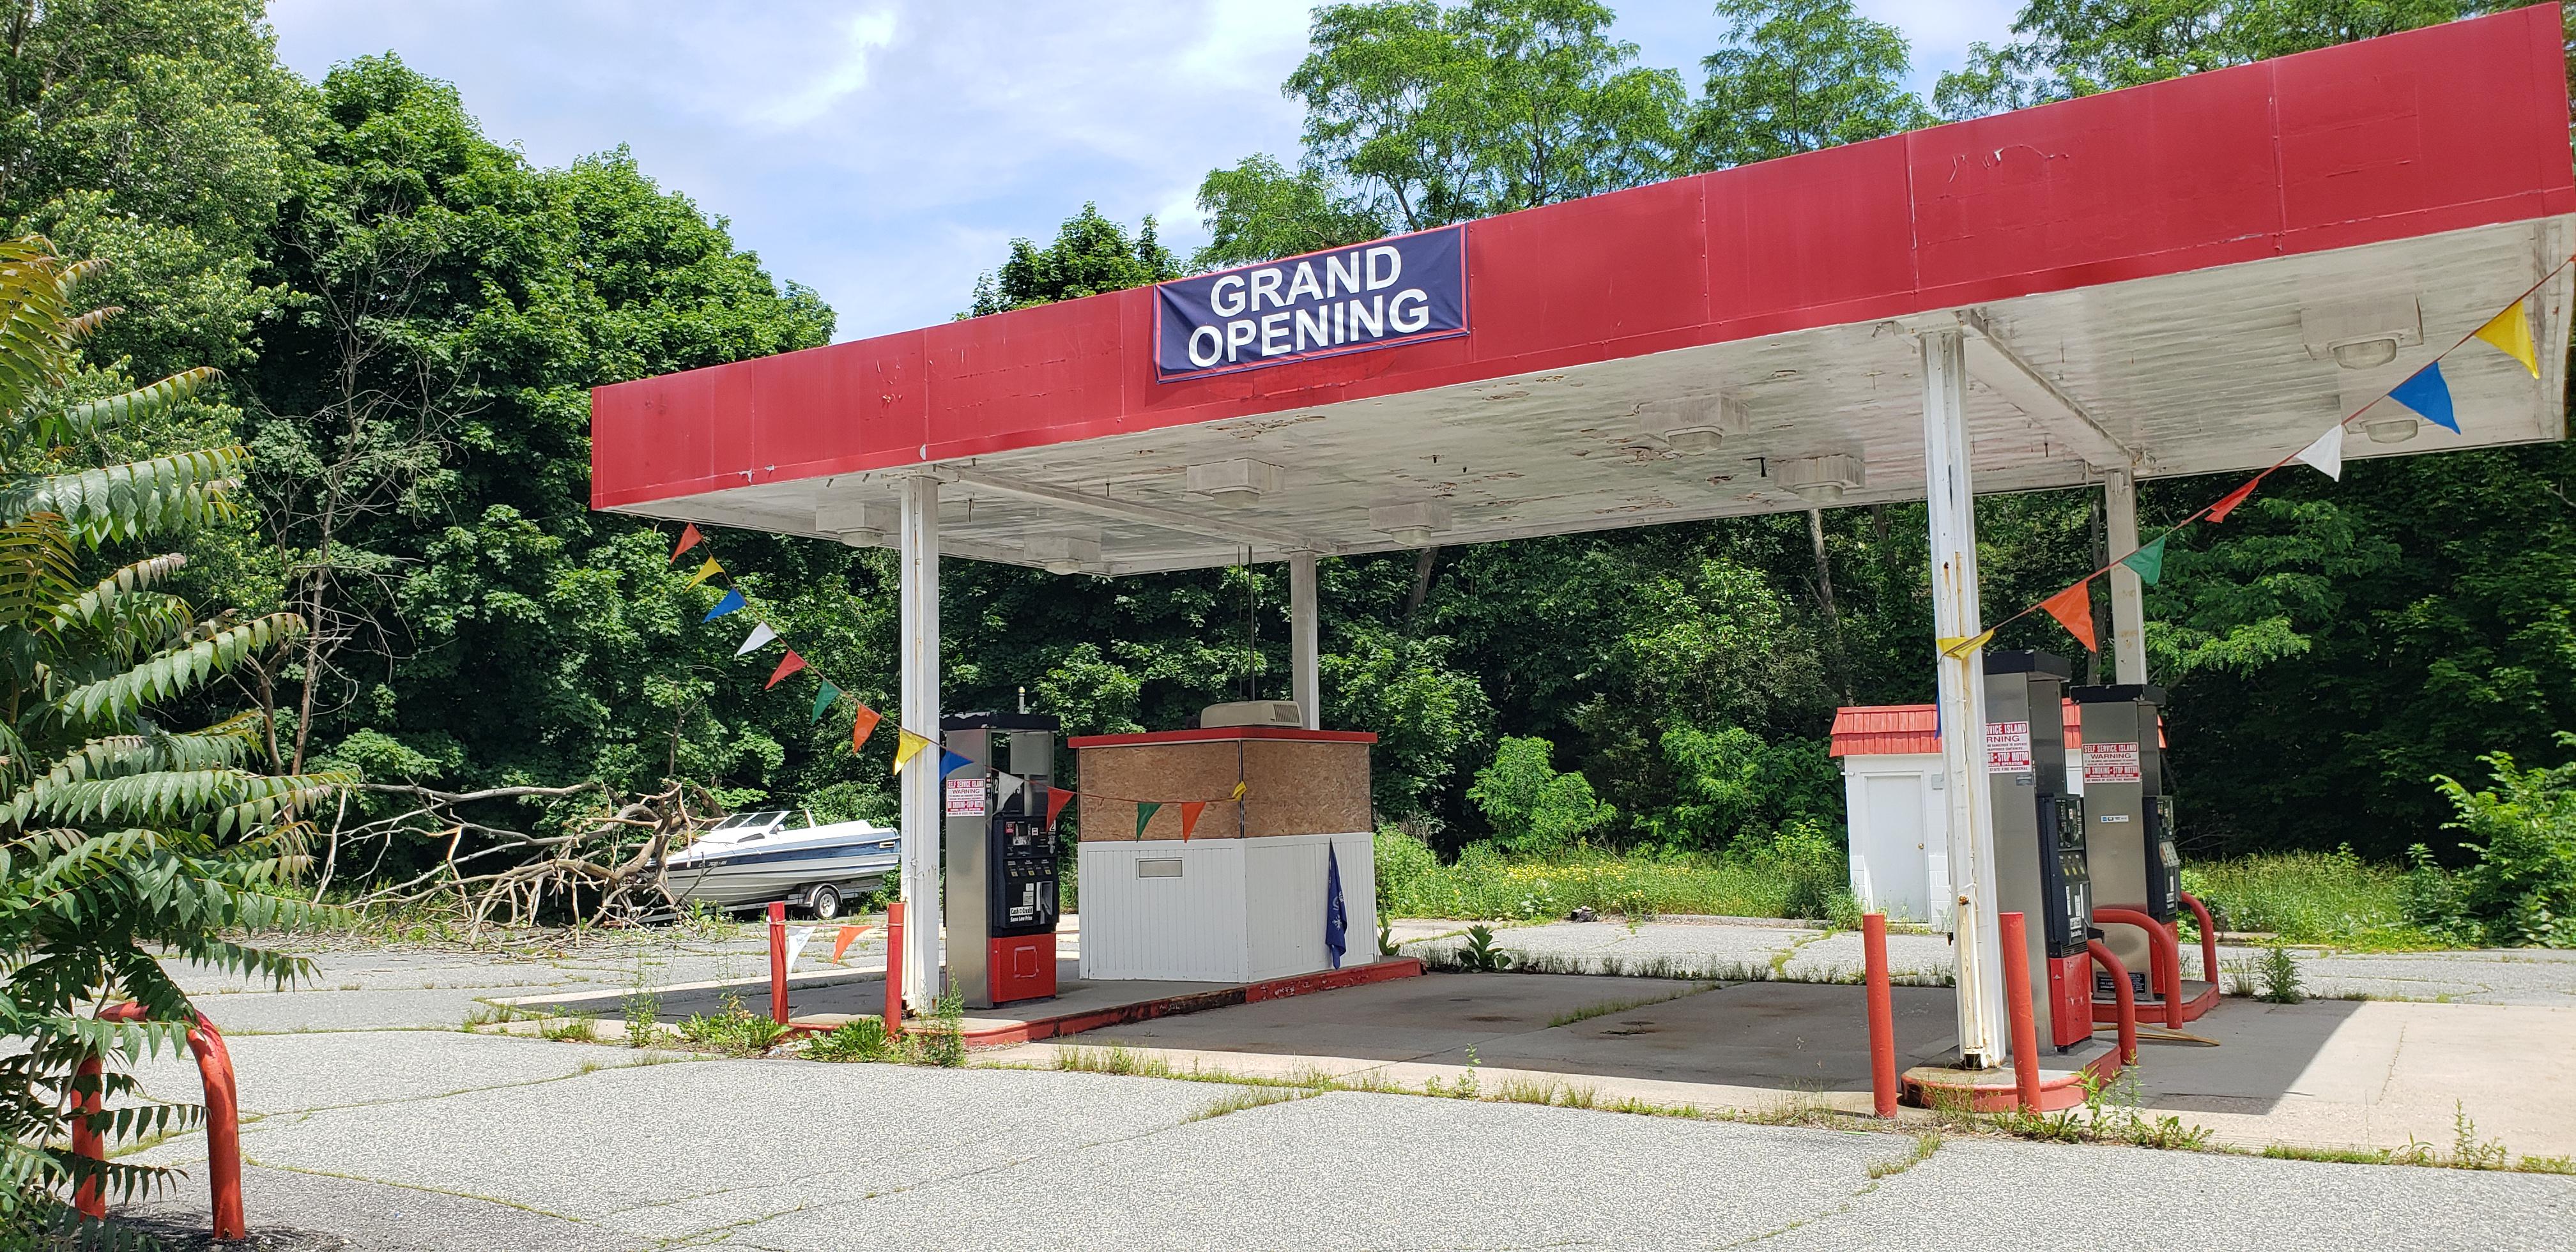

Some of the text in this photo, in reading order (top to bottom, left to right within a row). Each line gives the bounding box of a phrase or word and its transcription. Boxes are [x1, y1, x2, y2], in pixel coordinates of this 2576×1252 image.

[1210, 245, 1402, 317] GRAND
[1188, 288, 1430, 367] OPENING
[1986, 723, 2027, 735] RVICE ISLAND
[2097, 744, 2117, 752] SERVICE
[2119, 744, 2136, 752] ISLAND
[1998, 752, 2010, 762] STOP
[2011, 751, 2028, 761] MOTOR
